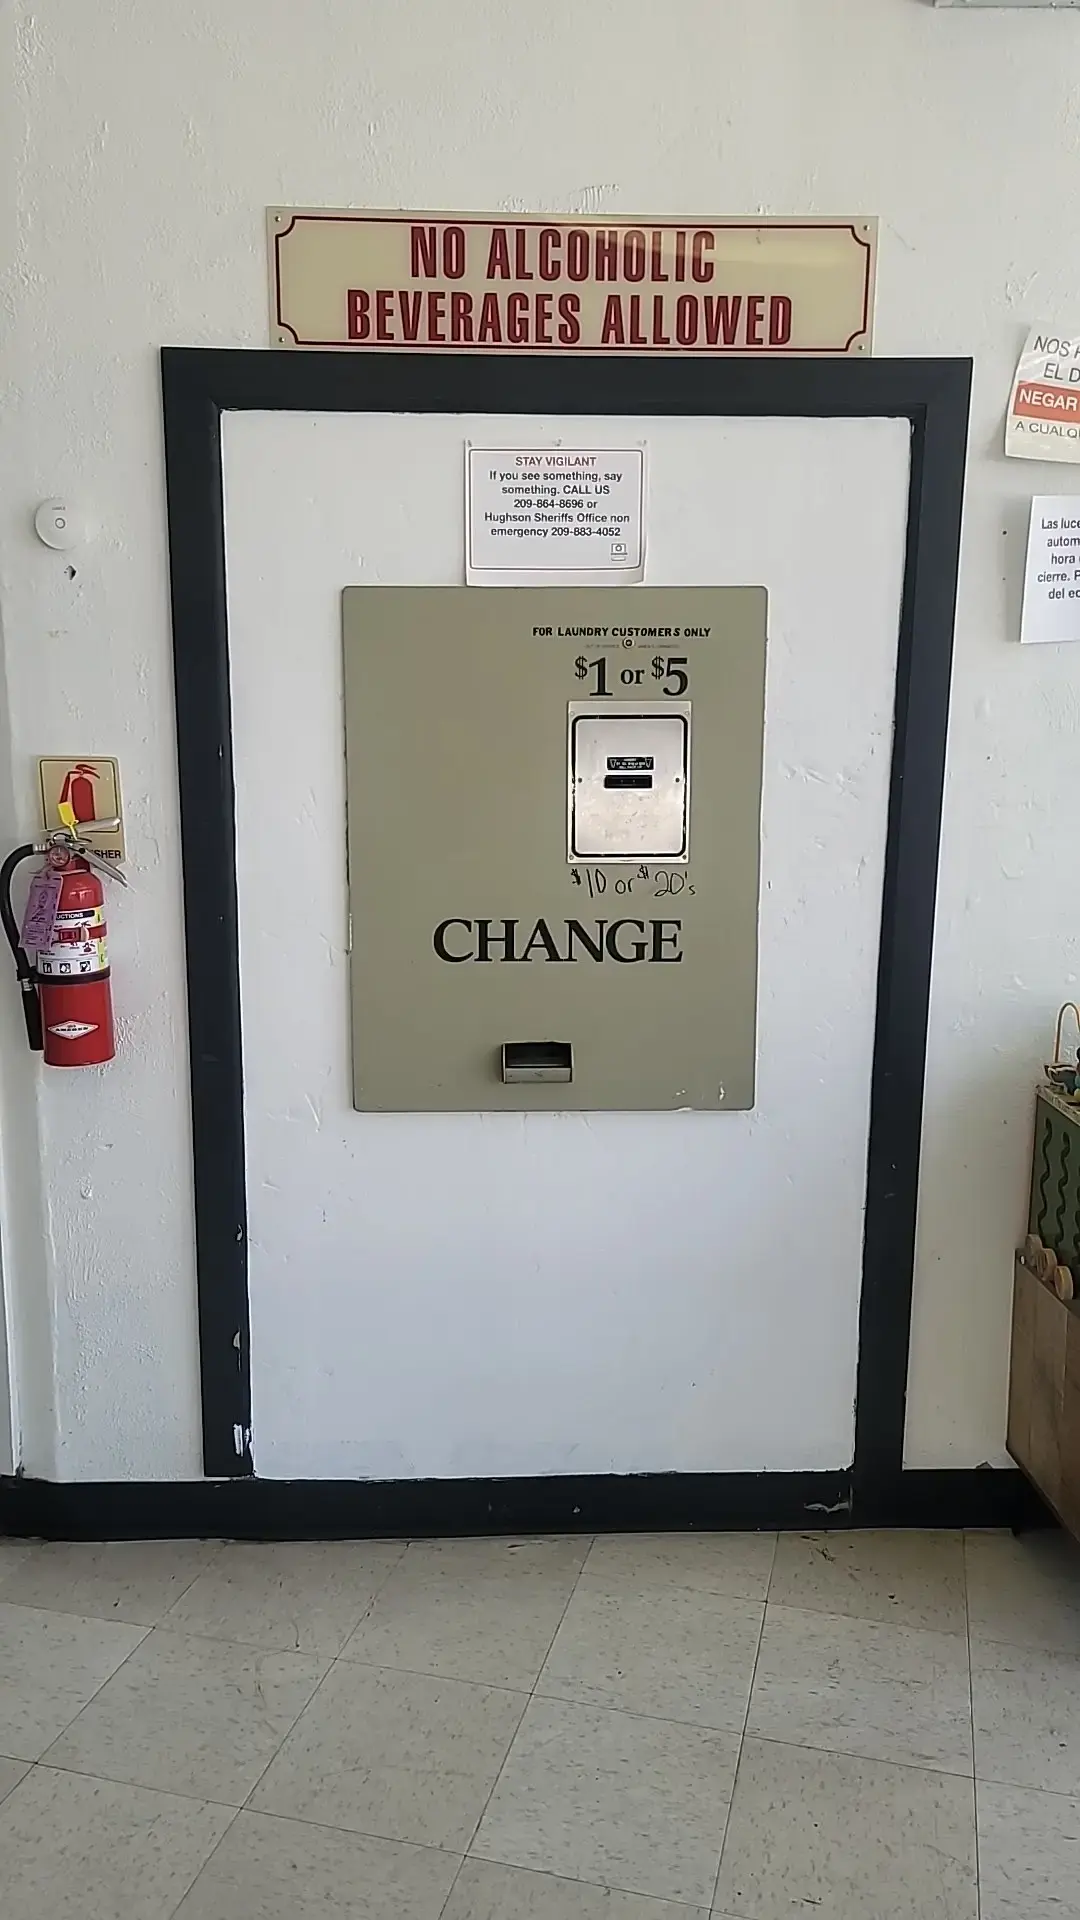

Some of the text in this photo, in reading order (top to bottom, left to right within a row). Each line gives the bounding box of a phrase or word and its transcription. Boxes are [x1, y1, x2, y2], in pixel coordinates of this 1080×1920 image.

[410, 226, 715, 283] NO ALCOHOLIC
[347, 289, 793, 346] BEVERAGES ALLOWED
[1033, 335, 1070, 358] NOS
[1043, 363, 1064, 380] EL
[1019, 388, 1078, 412] NEGAR
[1015, 420, 1080, 439] A CUALQ
[515, 456, 597, 467] STAY VIGILANT
[489, 471, 622, 482] If you see something, say
[502, 485, 610, 496] something. CALL US
[513, 499, 598, 509] 209-864-8696 or
[484, 512, 630, 524] Hughson Sheriffs Office non
[1041, 517, 1059, 530] Las
[490, 527, 621, 538] emergency 209-883-4052
[1051, 554, 1075, 565] hora
[1037, 571, 1070, 583] cierre.
[1048, 588, 1065, 600] del
[532, 626, 712, 638] FOR LAUNDRY CUSTOMERS ONLY
[574, 655, 689, 697] $1 or $5
[614, 876, 635, 896] or
[433, 918, 684, 963] CHANGE
